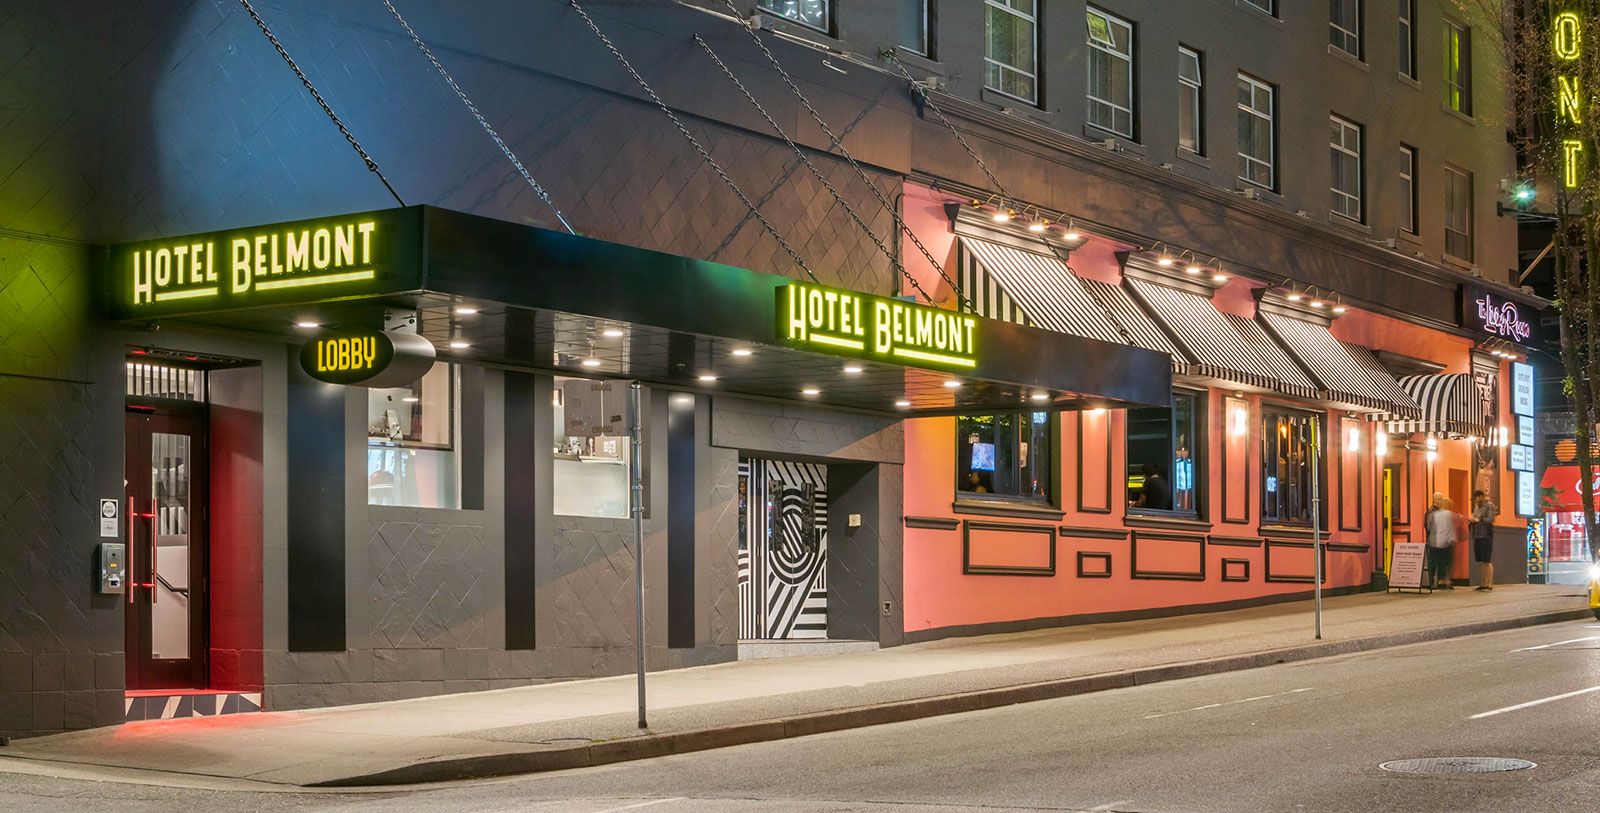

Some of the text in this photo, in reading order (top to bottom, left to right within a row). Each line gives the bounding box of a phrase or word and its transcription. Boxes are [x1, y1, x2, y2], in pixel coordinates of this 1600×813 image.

[133, 222, 376, 305] HOTEL BELMONT
[788, 284, 975, 354] HOTEL BELMONT
[317, 336, 376, 373] LOBBY
